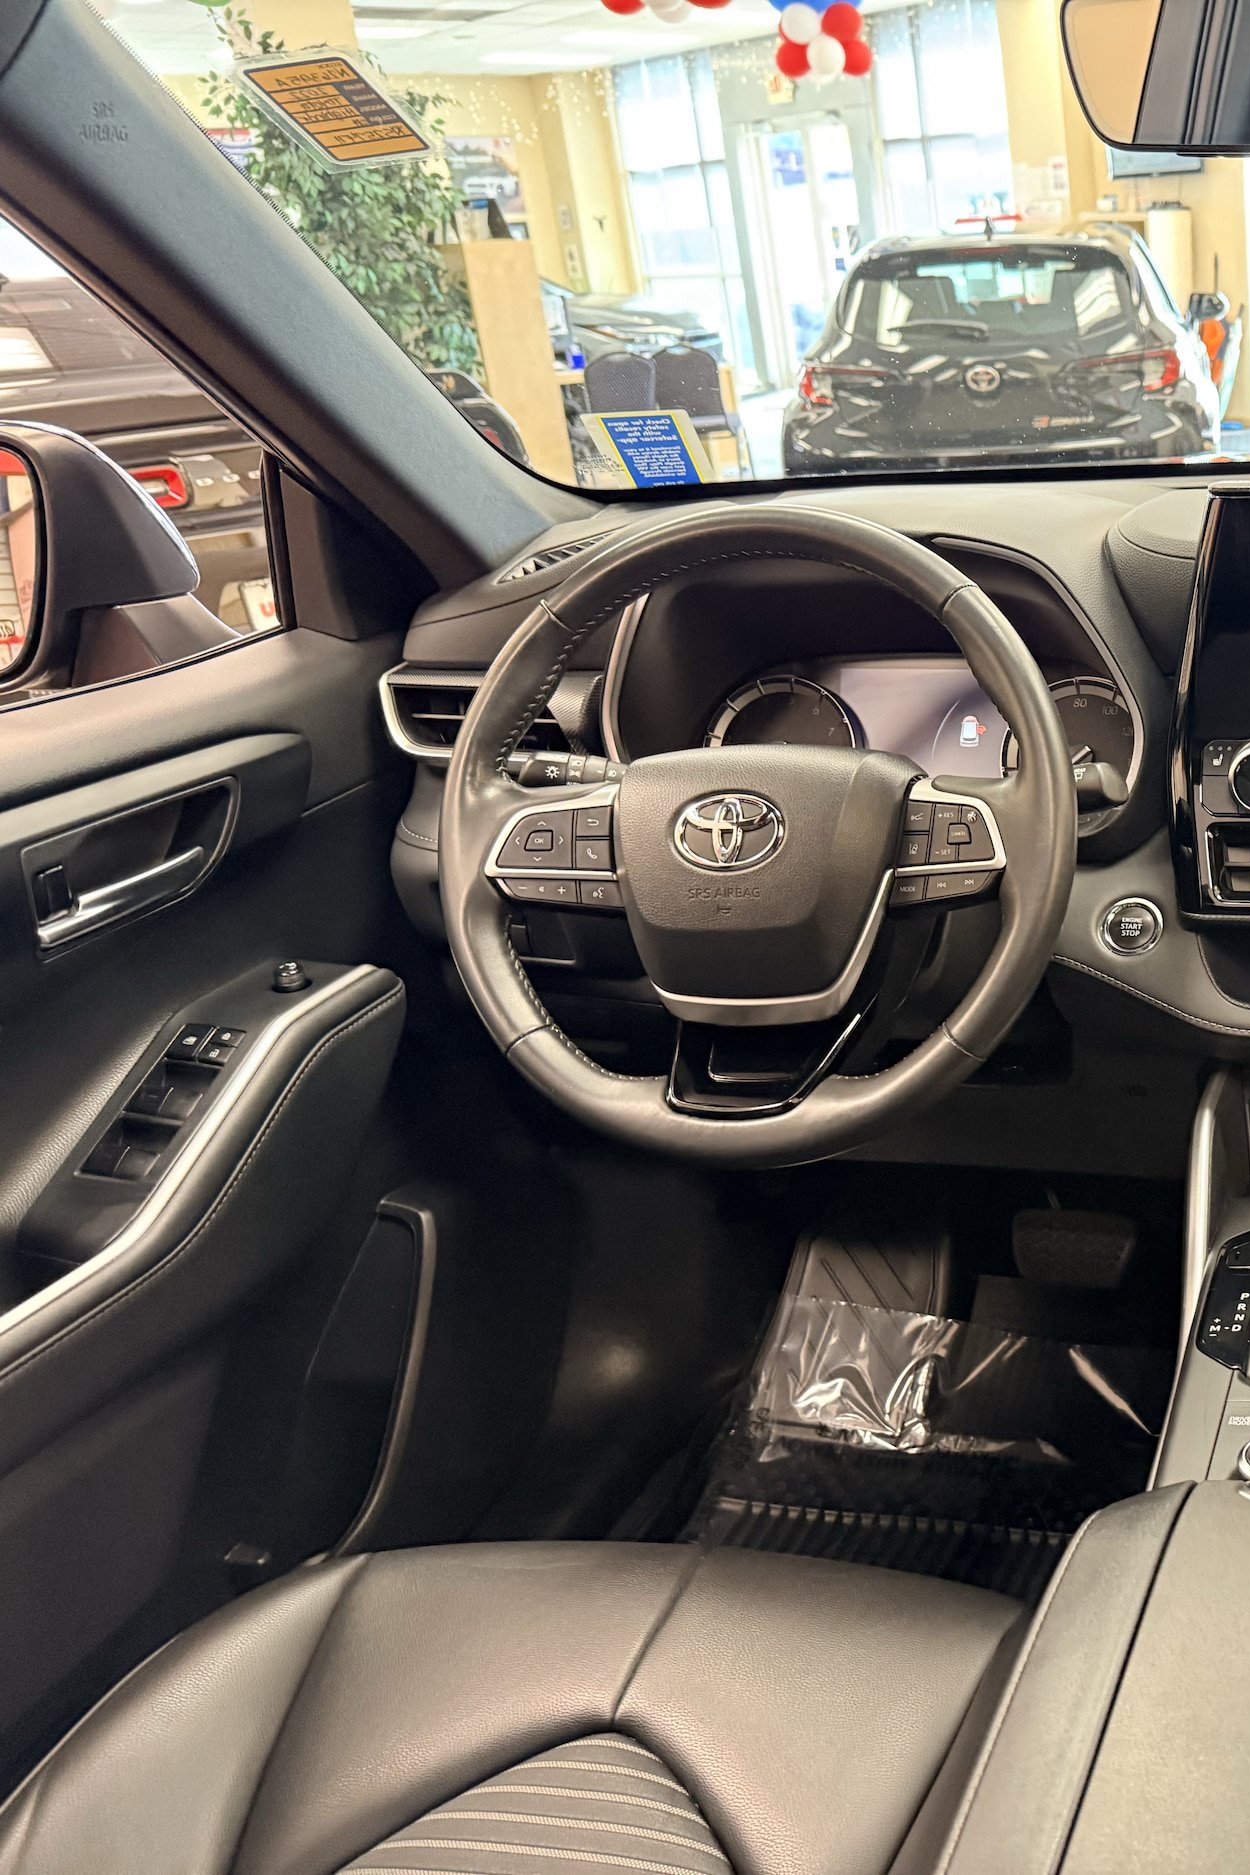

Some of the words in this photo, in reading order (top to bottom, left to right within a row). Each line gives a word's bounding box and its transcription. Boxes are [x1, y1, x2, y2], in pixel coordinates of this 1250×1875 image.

[1073, 698, 1088, 708] 80
[1103, 706, 1118, 715] 100
[688, 888, 711, 899] SRS
[715, 888, 760, 899] AIRBAG
